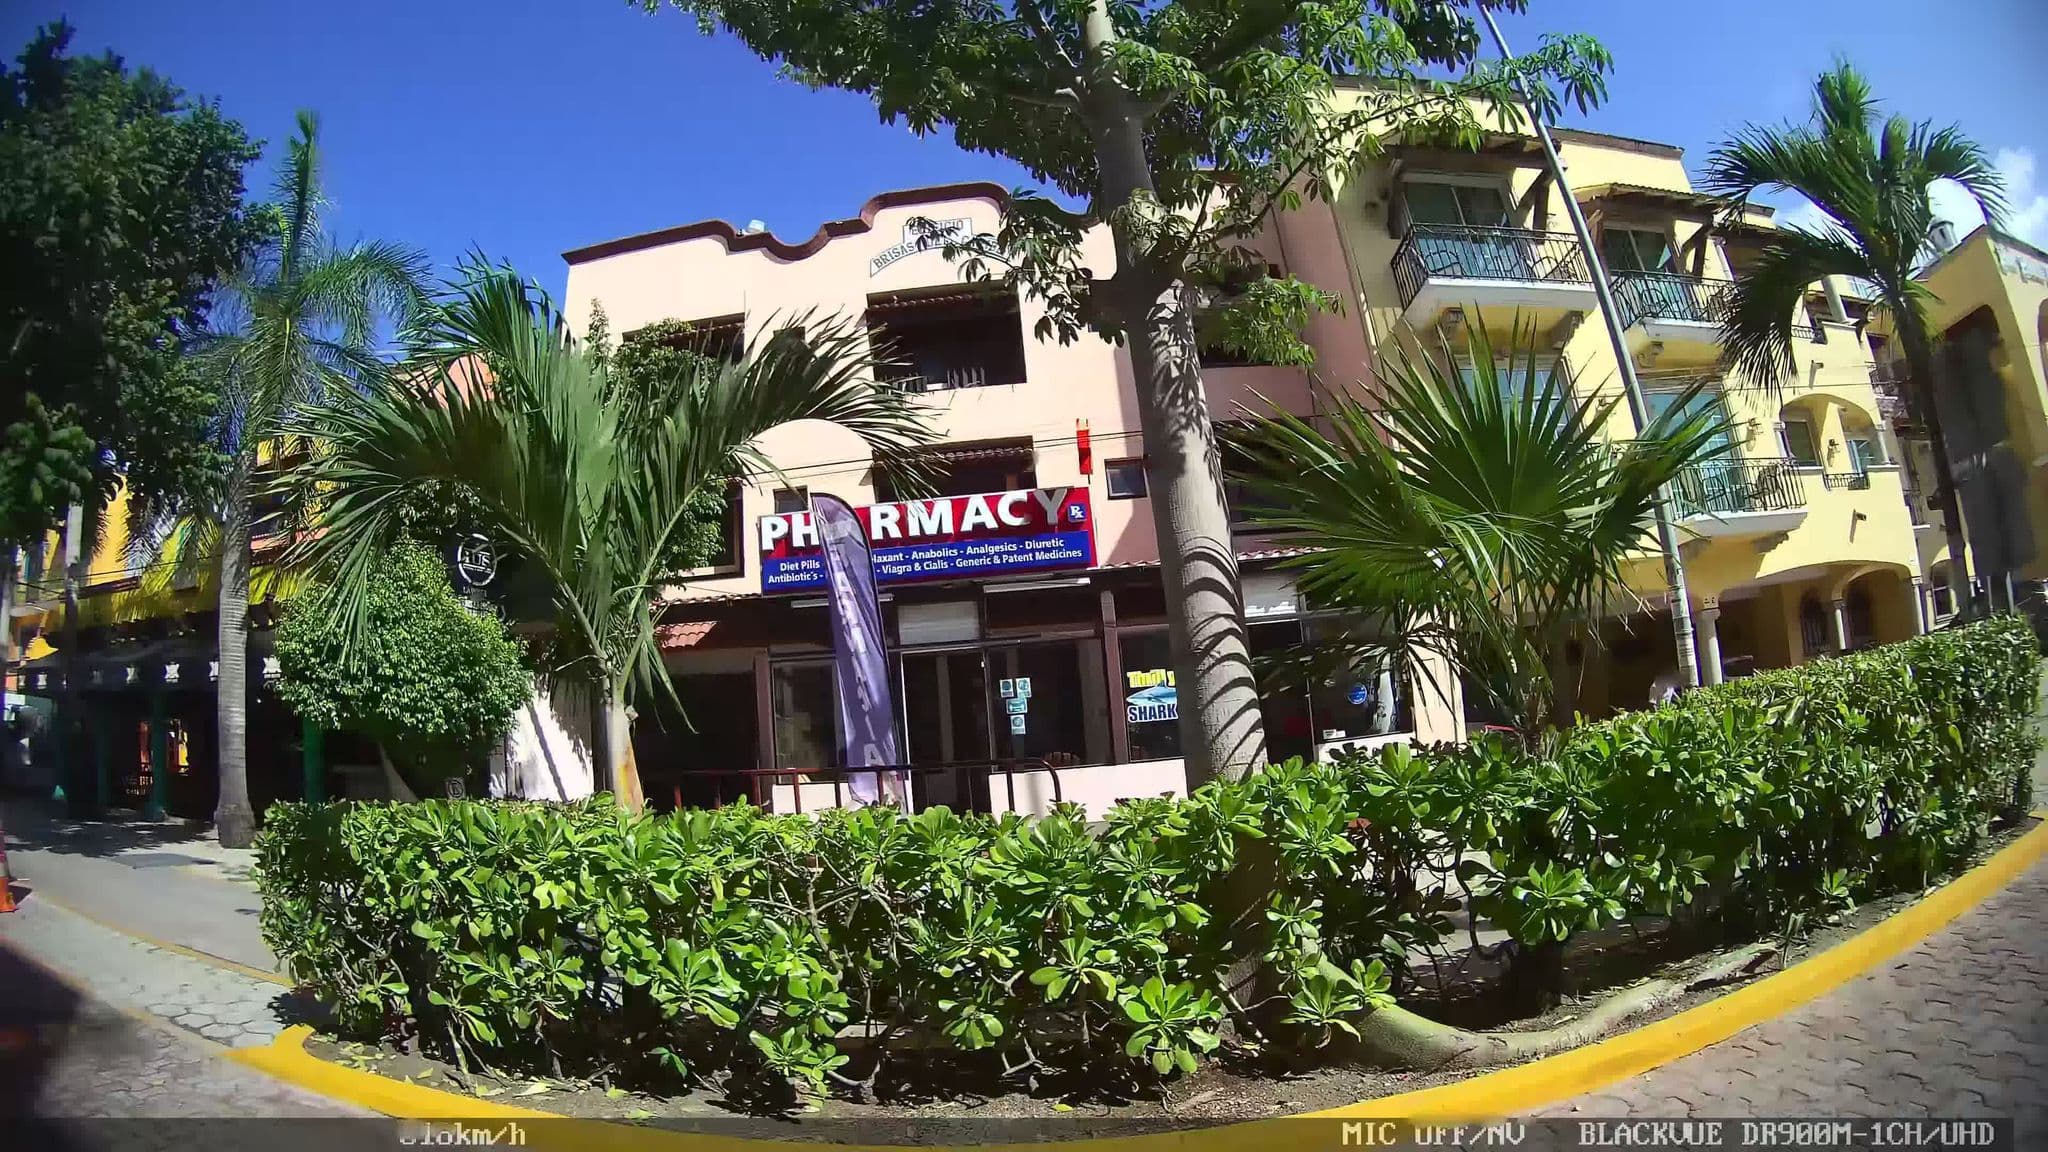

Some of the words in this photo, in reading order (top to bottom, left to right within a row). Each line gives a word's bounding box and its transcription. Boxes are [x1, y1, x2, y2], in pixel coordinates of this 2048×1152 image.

[873, 242, 915, 268] BRISAS
[761, 488, 1069, 550] PHRMACY
[780, 562, 799, 571] Diet
[801, 560, 820, 569] Pills
[872, 552, 904, 563] laxant
[911, 547, 958, 560] Anabolics
[966, 542, 1017, 555] Analgesics
[1025, 538, 1064, 549] Diuretic
[882, 564, 912, 574] Viagra
[923, 560, 948, 570] Cialis
[956, 555, 991, 567] Generic
[1002, 552, 1034, 564] Patent
[1035, 549, 1082, 560] Medicines
[1129, 703, 1177, 721] SHARK
